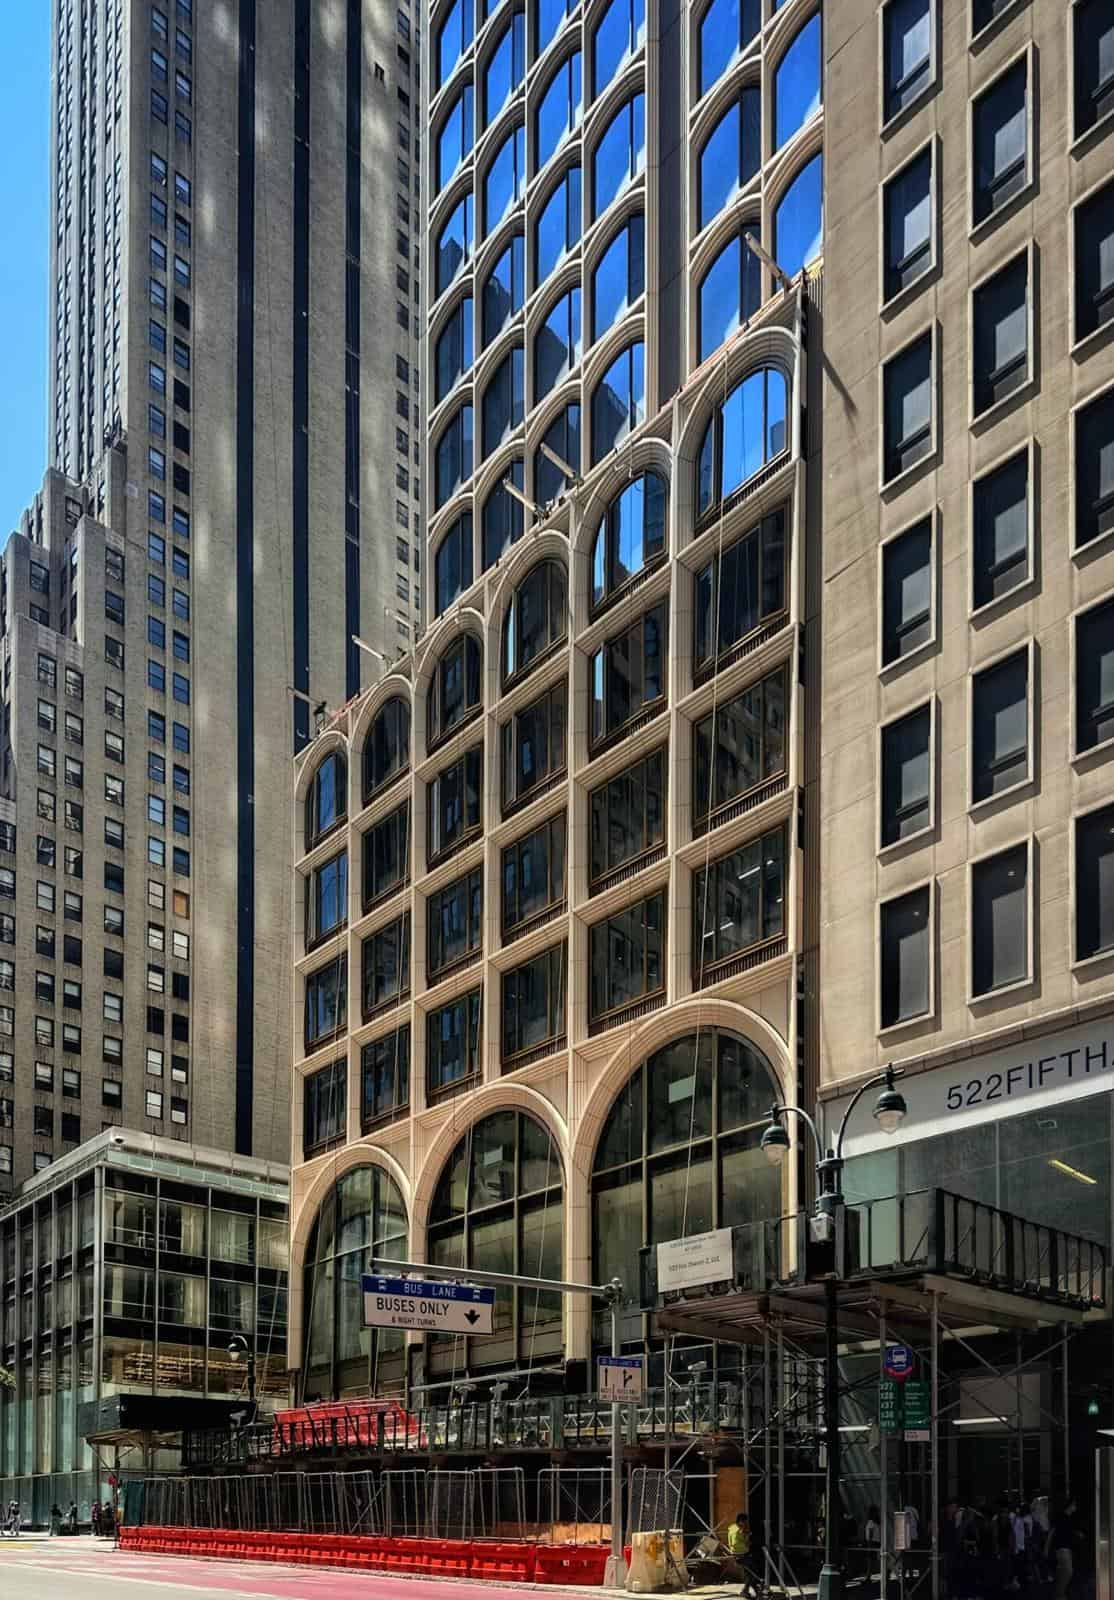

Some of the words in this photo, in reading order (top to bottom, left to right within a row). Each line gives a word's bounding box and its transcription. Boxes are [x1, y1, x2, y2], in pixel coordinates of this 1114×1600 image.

[947, 1041, 1114, 1110] 522FIFTH
[403, 1282, 423, 1295] BUS
[431, 1285, 457, 1298] LANE
[376, 1297, 416, 1313] BUSES
[420, 1301, 450, 1316] ONLY
[398, 1316, 415, 1326] RIGHT
[417, 1318, 437, 1327] TURNS
